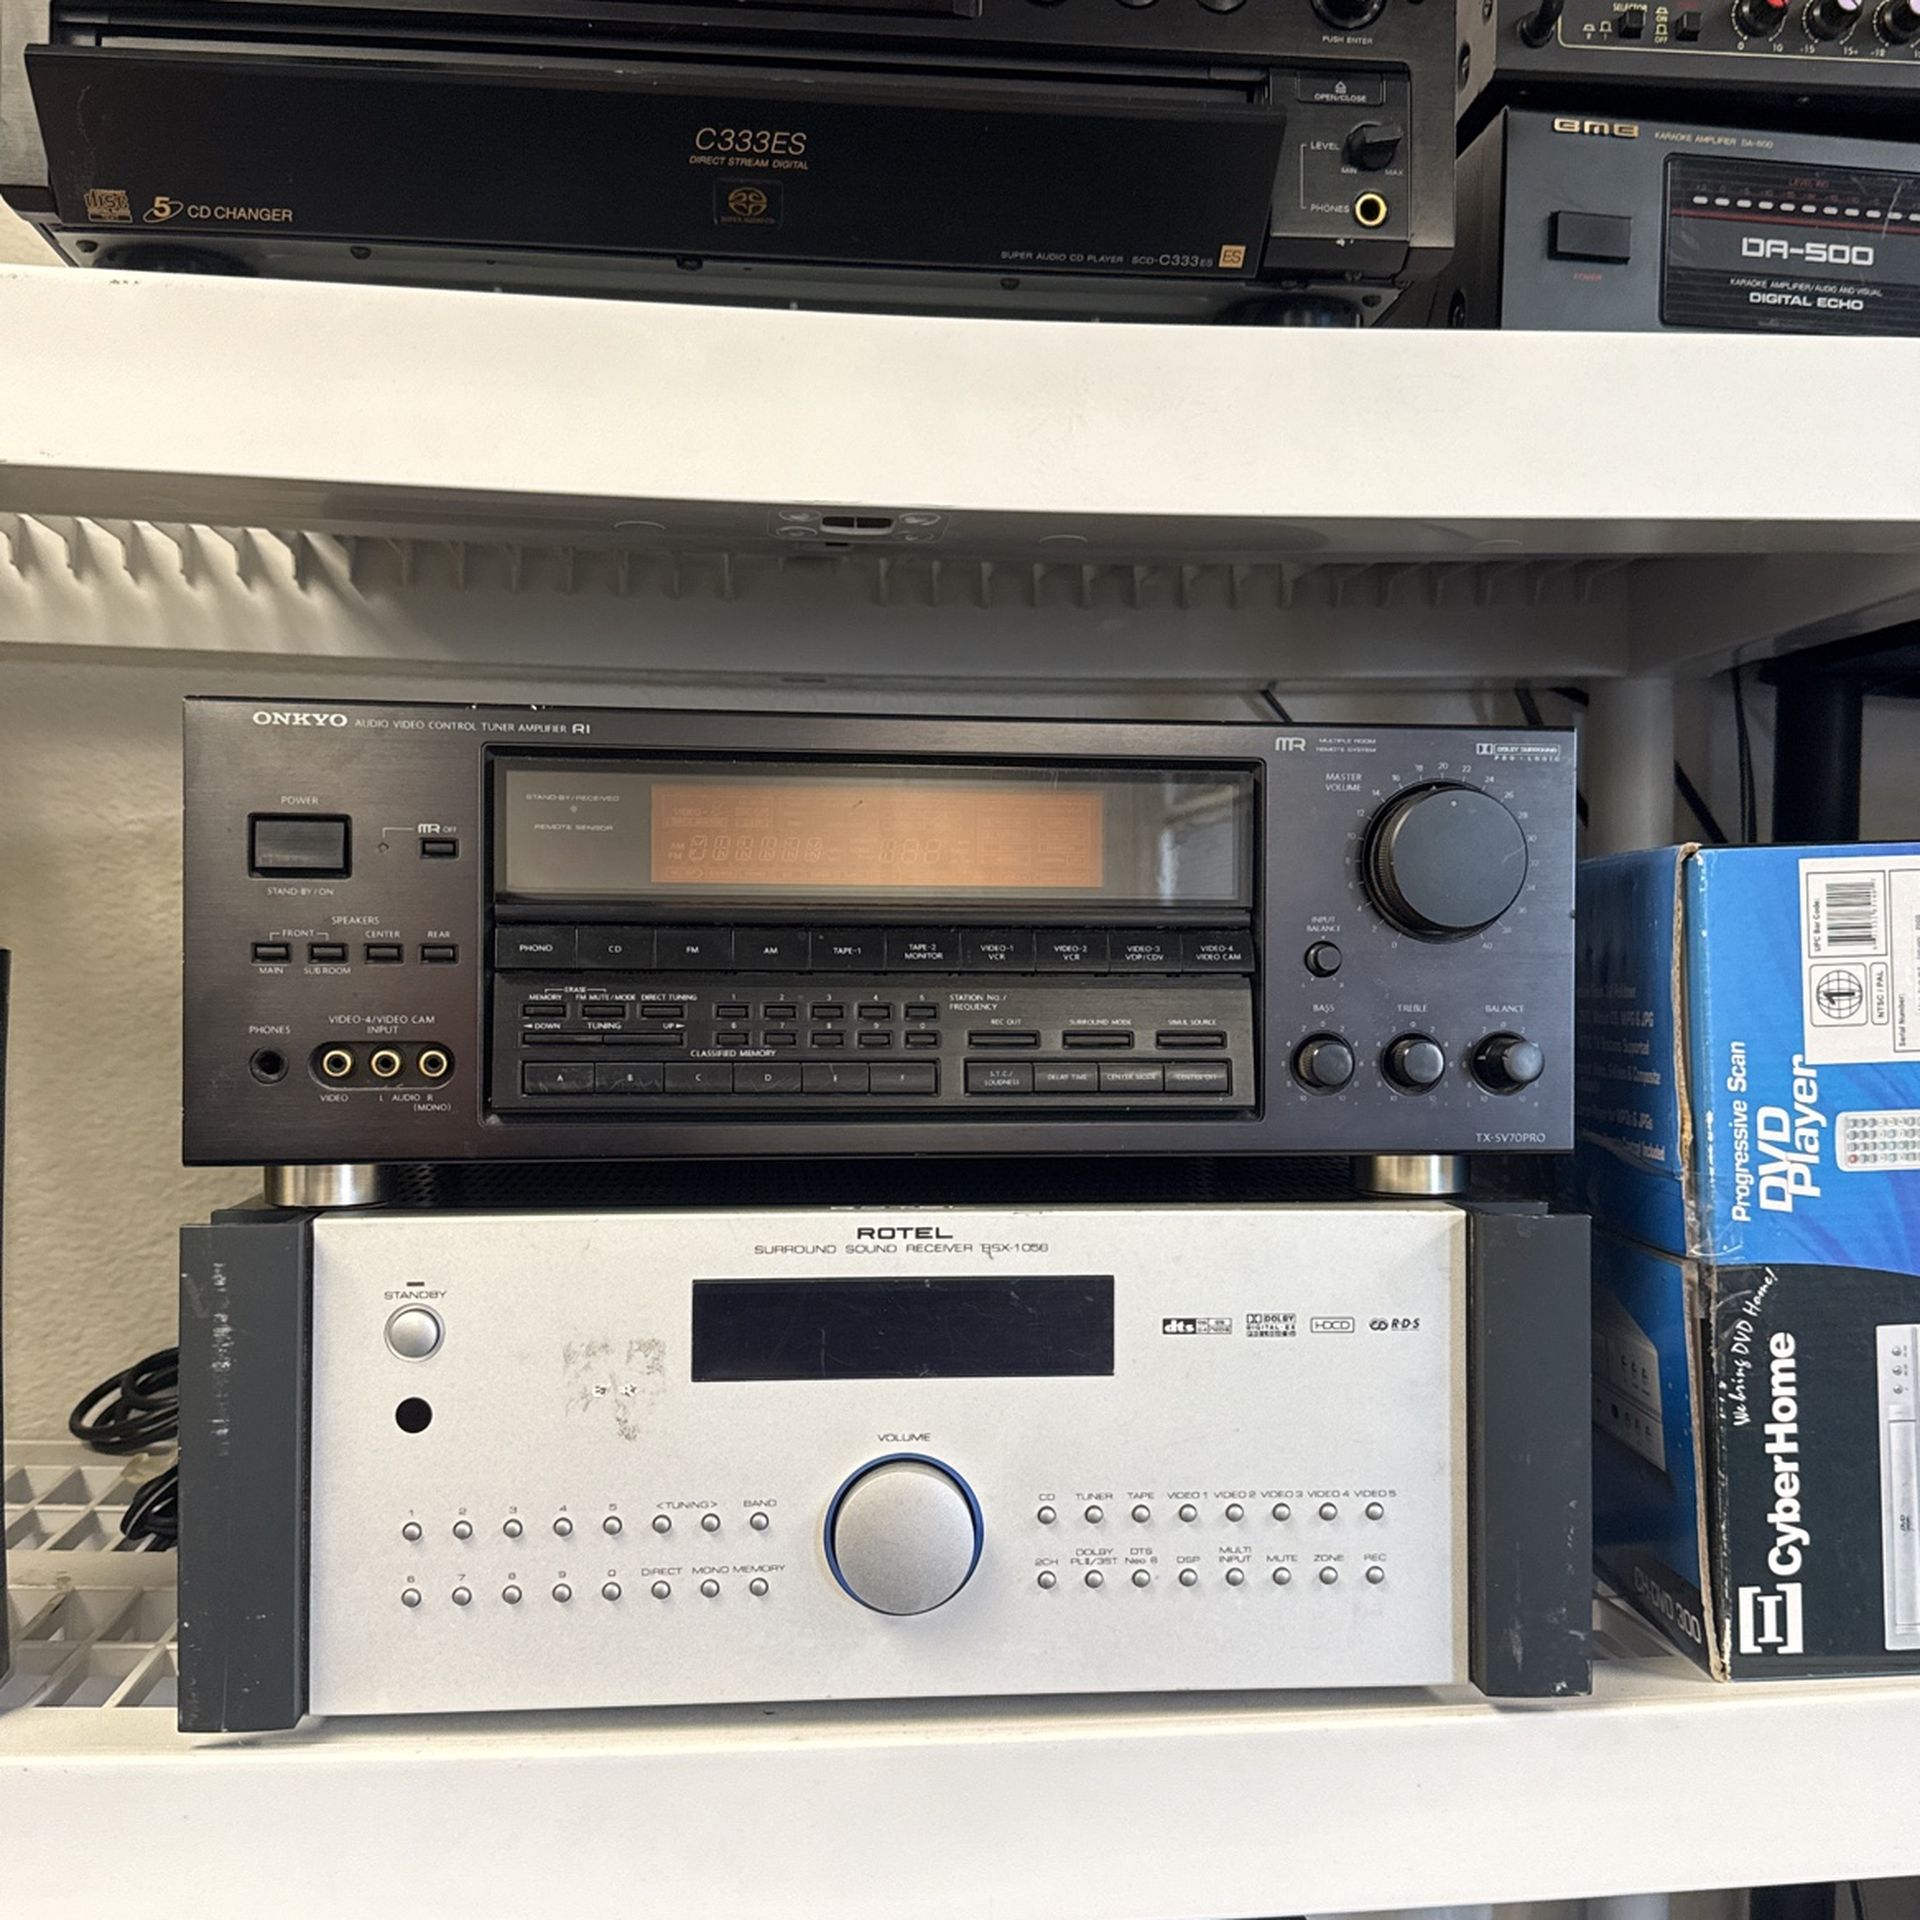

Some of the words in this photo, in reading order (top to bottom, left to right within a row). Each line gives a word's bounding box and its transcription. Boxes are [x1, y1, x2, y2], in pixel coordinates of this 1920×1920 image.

[1322, 35, 1344, 43] PUSH
[1347, 37, 1373, 45] ENTER
[1773, 43, 1784, 52] 10
[1314, 93, 1367, 102] OPEN/CLOSE
[695, 127, 807, 155] C333ES
[1655, 131, 1693, 144] KARAOKE
[1694, 134, 1737, 146] AMPLIFIER
[1310, 141, 1340, 150] LEVEL
[689, 155, 726, 165] DIRECT
[728, 157, 769, 168] STREAM
[772, 159, 808, 170] DIGITAL
[153, 196, 171, 218] 5
[187, 205, 211, 219] CD
[214, 206, 293, 222] CHANGER
[1310, 204, 1350, 213] PHONES
[1741, 237, 1874, 266] DA-500
[1001, 250, 1033, 260] SUPER
[1036, 252, 1066, 262] AUDIO
[1069, 253, 1084, 262] CD
[1087, 254, 1124, 264] PLAYER
[1223, 250, 1243, 263] ES
[1730, 278, 1767, 288] KARAOKE
[1750, 292, 1812, 307] DIGITAL
[1817, 297, 1864, 311] ECHO
[252, 711, 348, 728] ONKYO
[354, 718, 389, 729] AUDIO
[393, 719, 425, 730] VIDEO
[428, 721, 477, 732] CONTROL
[481, 722, 515, 733] TUNER
[518, 724, 567, 734] AMPLIFIER
[1437, 762, 1449, 771] 20
[1461, 765, 1472, 773] 22
[1325, 773, 1362, 782] MASTER
[1484, 776, 1495, 784] 24
[1325, 783, 1361, 792] VOLUME
[281, 796, 319, 805] POWER
[533, 823, 572, 831] REMOTE
[575, 824, 614, 832] SENSOR
[1812, 898, 1821, 920] Code:
[331, 916, 380, 925] SPEAKERS
[1311, 916, 1336, 924] INPUT
[1306, 924, 1341, 933] BALANCE
[282, 929, 314, 938] FRONT
[365, 930, 400, 939] CENTER
[427, 930, 451, 939] REAR
[519, 943, 553, 953] PHONO
[608, 945, 622, 953] CD
[686, 945, 699, 954] FM
[763, 946, 778, 955] AM
[832, 946, 862, 955] TAPE-1
[909, 943, 936, 951] TAPE-2
[980, 944, 1014, 952] VIDEO-1
[1053, 944, 1088, 953] VIDEO-2
[1126, 945, 1160, 953] VIDEO-3
[1200, 944, 1234, 953] VIDEO-4
[904, 951, 943, 960] MONITOR
[988, 952, 1005, 961] VCR
[1063, 953, 1081, 961] VCR
[1196, 953, 1221, 961] VIDEO
[1222, 953, 1241, 961] CAM
[259, 967, 284, 975] MAIN
[303, 967, 320, 975] SUB
[322, 967, 351, 975] ROOM
[1876, 970, 1884, 987] PAL
[529, 993, 562, 1001] MEMORY
[575, 993, 586, 1001] FM
[589, 993, 636, 1001] MUTE/MODE
[641, 993, 666, 1001] DIRECT
[668, 993, 697, 1001] TUNING
[949, 1003, 998, 1011] FREQUENCY
[1313, 1004, 1335, 1013] BASS
[1397, 1004, 1428, 1013] TREBLE
[1485, 1004, 1524, 1013] BALANCE
[1876, 995, 1885, 1018] NTSC
[328, 1015, 409, 1024] VIDEO-4/VIDEO
[411, 1015, 435, 1024] CAM
[1068, 1018, 1109, 1026] SURROUND
[1111, 1018, 1132, 1026] MODE
[248, 1025, 291, 1034] PHONES
[366, 1025, 399, 1034] INPUT
[534, 1022, 561, 1030] DOWN
[587, 1022, 622, 1030] TUNING
[1727, 1040, 1747, 1093] Scan
[320, 1094, 349, 1102] VIDEO
[413, 1103, 451, 1112] (MONO)
[1786, 1053, 1827, 1198] Player
[1475, 1132, 1546, 1144] TX-SV70PRO
[1728, 1100, 1755, 1222] Progressive
[1756, 1105, 1793, 1213] DVD
[857, 1227, 953, 1240] ROTEL
[754, 1244, 837, 1254] SURROUND
[845, 1244, 897, 1254] SOUND
[906, 1243, 973, 1252] RECEIVER
[384, 1290, 447, 1300] STANDBY
[1742, 1266, 1779, 1317] Home!
[1164, 1320, 1194, 1333] dts
[1730, 1320, 1754, 1355] DVD
[1728, 1358, 1752, 1401] bring
[1733, 1404, 1751, 1426] We
[877, 1433, 931, 1442] VOLUME
[1765, 1331, 1810, 1577] CyberHome
[1038, 1492, 1056, 1501] CD
[1075, 1492, 1113, 1501] TUNER
[1127, 1492, 1155, 1501] TAPE
[1167, 1491, 1201, 1500] VIDEO
[1203, 1491, 1208, 1500] 1
[1213, 1491, 1247, 1500] VIDEO
[1248, 1491, 1256, 1500] 2
[1260, 1491, 1294, 1500] VIDEO
[1295, 1491, 1303, 1500] 3
[1307, 1490, 1341, 1499] VIDEO
[1342, 1490, 1350, 1499] 4
[1354, 1489, 1387, 1498] VIDEO
[1388, 1489, 1397, 1498] 5
[743, 1499, 777, 1508] BAND
[1075, 1548, 1113, 1556] DOLBY
[1130, 1547, 1152, 1555] DTS
[1218, 1546, 1252, 1555] MULTI
[1176, 1556, 1200, 1565] DSP
[1218, 1555, 1252, 1564] INPUT
[1265, 1554, 1298, 1563] MUTE
[1313, 1553, 1344, 1562] ZONE
[1364, 1553, 1387, 1562] REC
[1035, 1558, 1058, 1567] 2CH
[641, 1567, 683, 1577] DIRECT
[692, 1566, 730, 1575] MONO
[732, 1564, 785, 1575] MEMORY
[1675, 1602, 1701, 1645] 300
